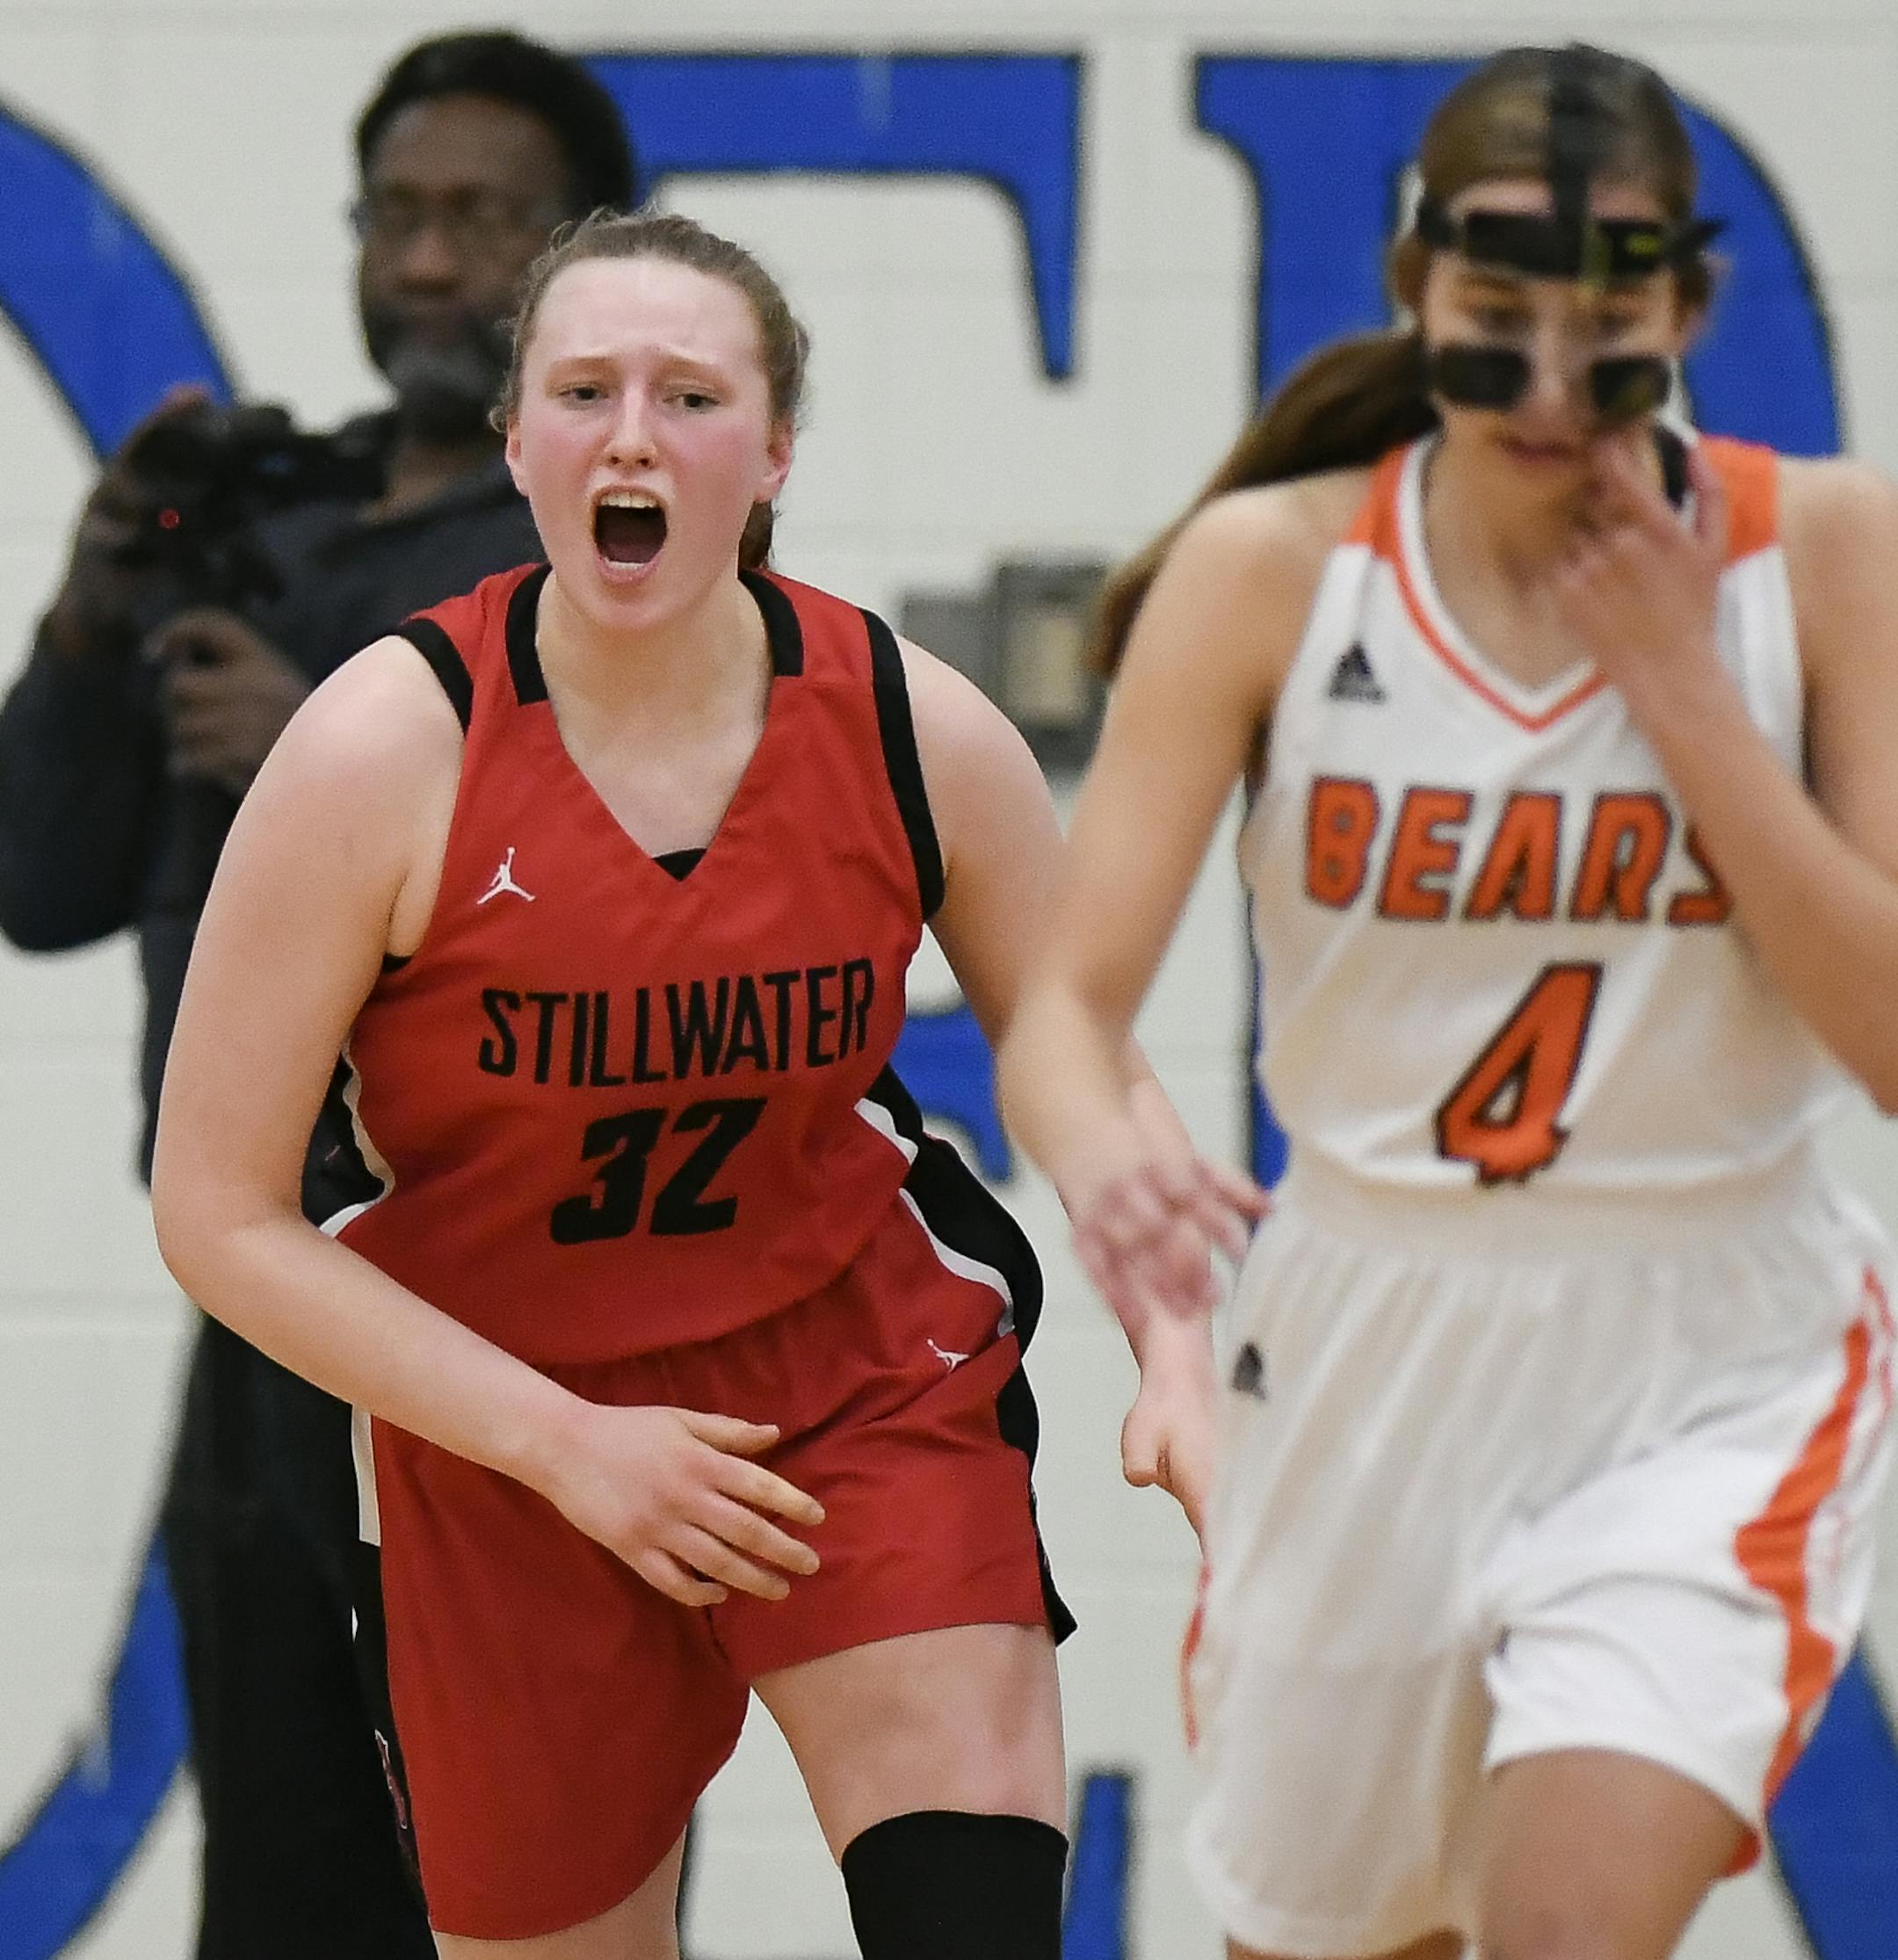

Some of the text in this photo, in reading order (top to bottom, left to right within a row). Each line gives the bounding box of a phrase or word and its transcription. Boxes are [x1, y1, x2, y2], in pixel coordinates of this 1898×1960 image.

[479, 957, 875, 1087] STILLWATER
[1434, 961, 1604, 1187] 4
[550, 1096, 767, 1245] 32
